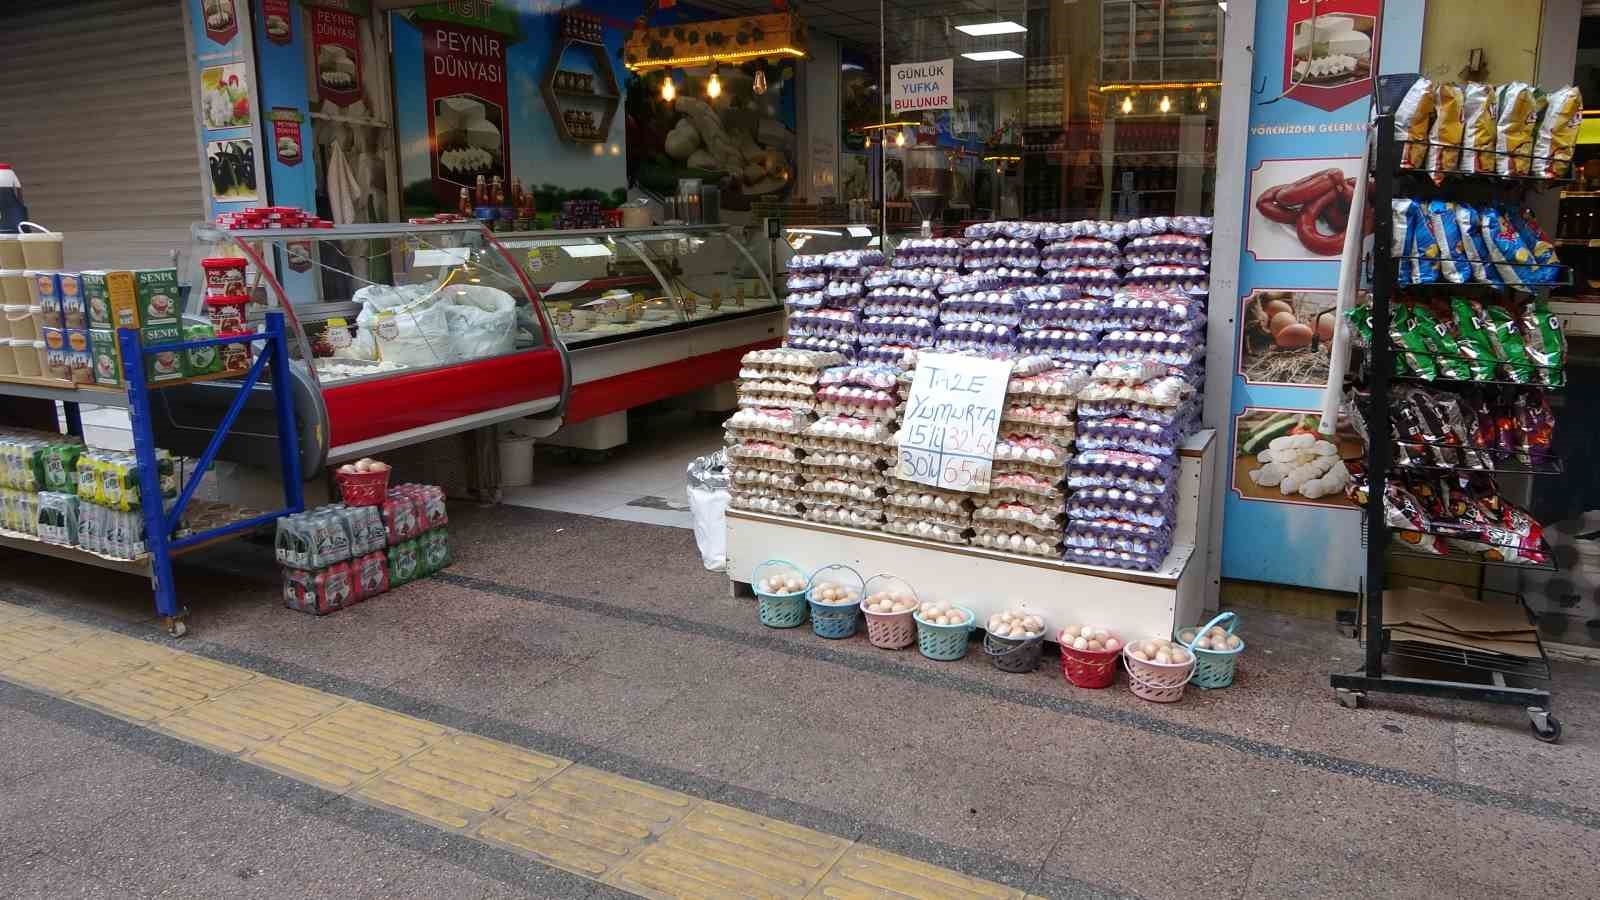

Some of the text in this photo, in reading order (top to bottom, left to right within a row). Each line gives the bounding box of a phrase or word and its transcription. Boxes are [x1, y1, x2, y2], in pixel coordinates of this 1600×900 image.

[436, 30, 501, 58] PEYNİR
[434, 55, 503, 84] DÜNYASI
[897, 65, 945, 80] GÜNLÜK
[902, 81, 940, 95] YUFKA
[894, 95, 948, 110] BULUNUR
[1319, 120, 1353, 134] GELEN
[140, 271, 175, 283] SENPA
[907, 394, 996, 431] YUMURTA
